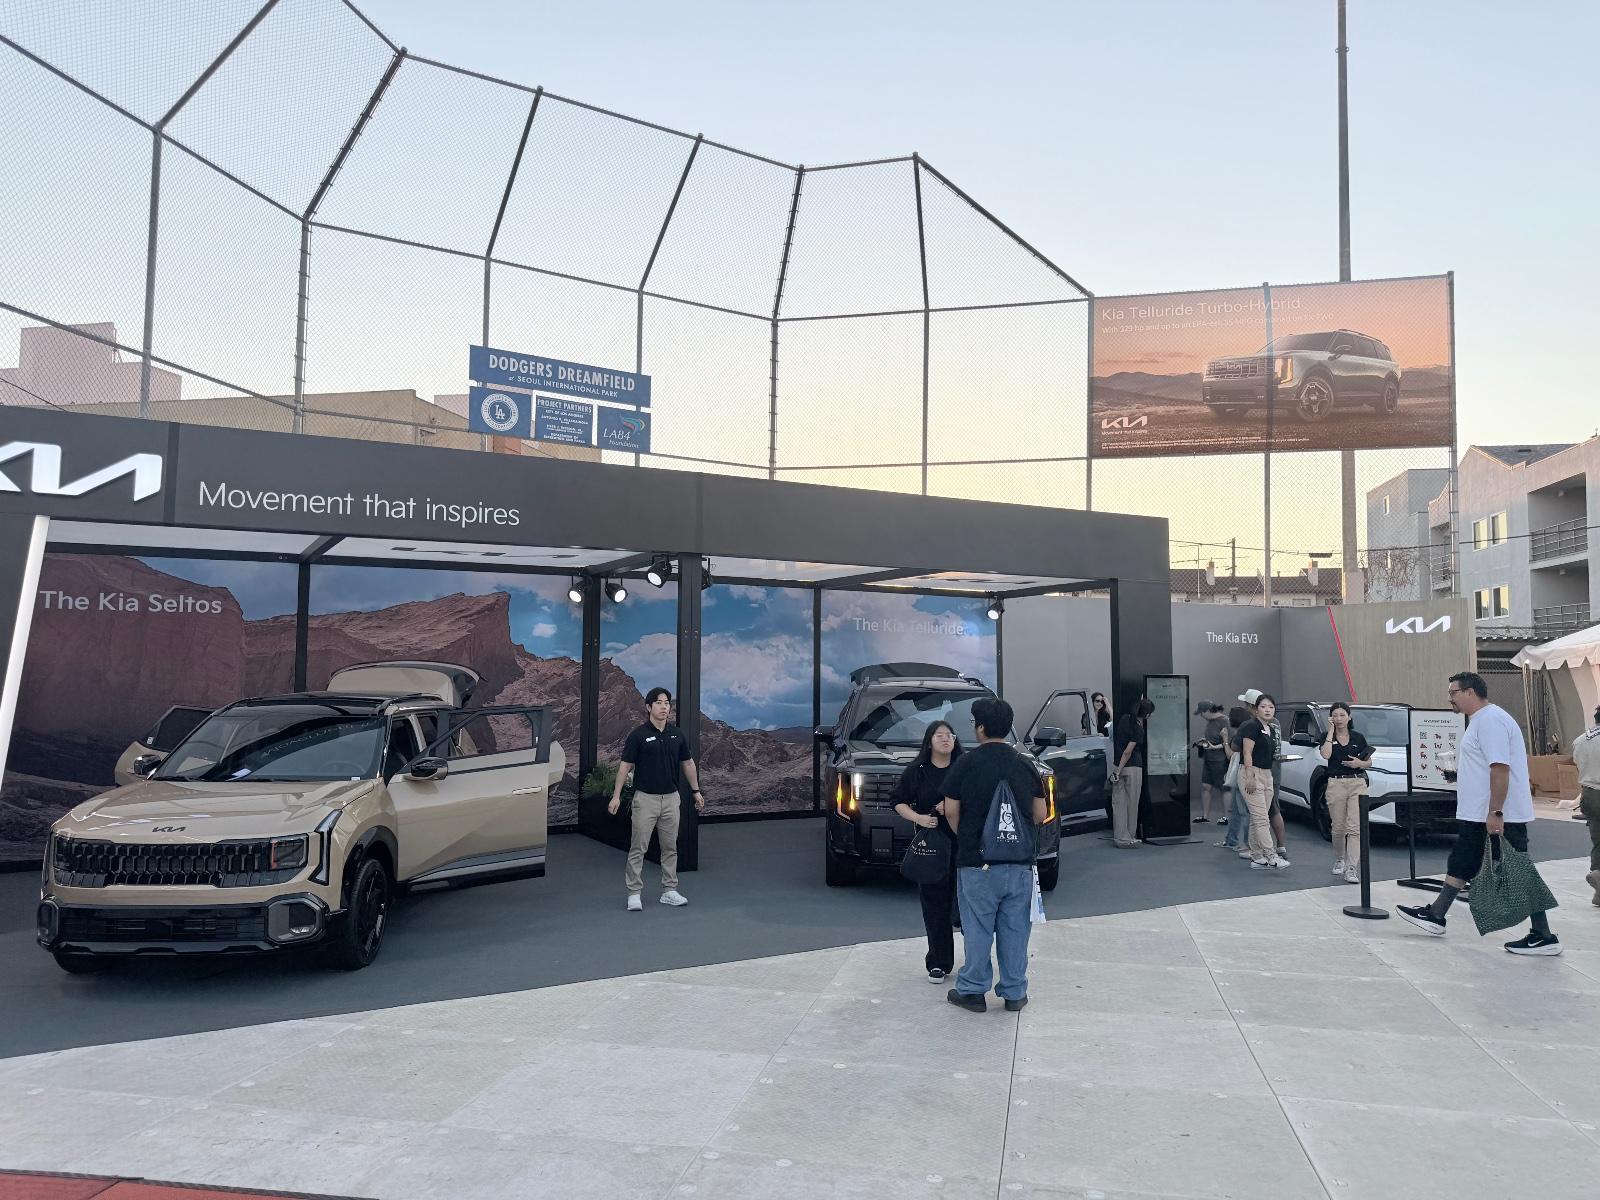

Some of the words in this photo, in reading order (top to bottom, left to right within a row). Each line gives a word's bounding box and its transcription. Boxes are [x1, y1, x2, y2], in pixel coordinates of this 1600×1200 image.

[1102, 308, 1124, 320] Kia
[1128, 304, 1193, 319] Telluride
[1197, 296, 1301, 315] Turbo-Hybrid
[489, 354, 553, 378] DODGERS
[558, 366, 635, 391] DREAMFIELD
[517, 376, 542, 386] SEOUL
[543, 380, 600, 395] INTERNATIONAL
[601, 390, 618, 398] PARK
[537, 398, 562, 409] PROJECT
[563, 402, 592, 413] PARTNERS
[603, 428, 631, 440] LA84
[199, 481, 354, 515] Movement
[363, 493, 416, 520] that
[426, 497, 520, 528] inspires
[40, 590, 90, 610] The
[99, 592, 139, 612] Kia
[148, 593, 222, 614] Seltos
[853, 617, 879, 631] The
[883, 619, 905, 632] Kia
[910, 620, 964, 635] Telluride
[1385, 616, 1451, 634] KIA
[1205, 631, 1223, 643] The
[1225, 632, 1240, 643] Kia
[1241, 633, 1258, 644] EV3
